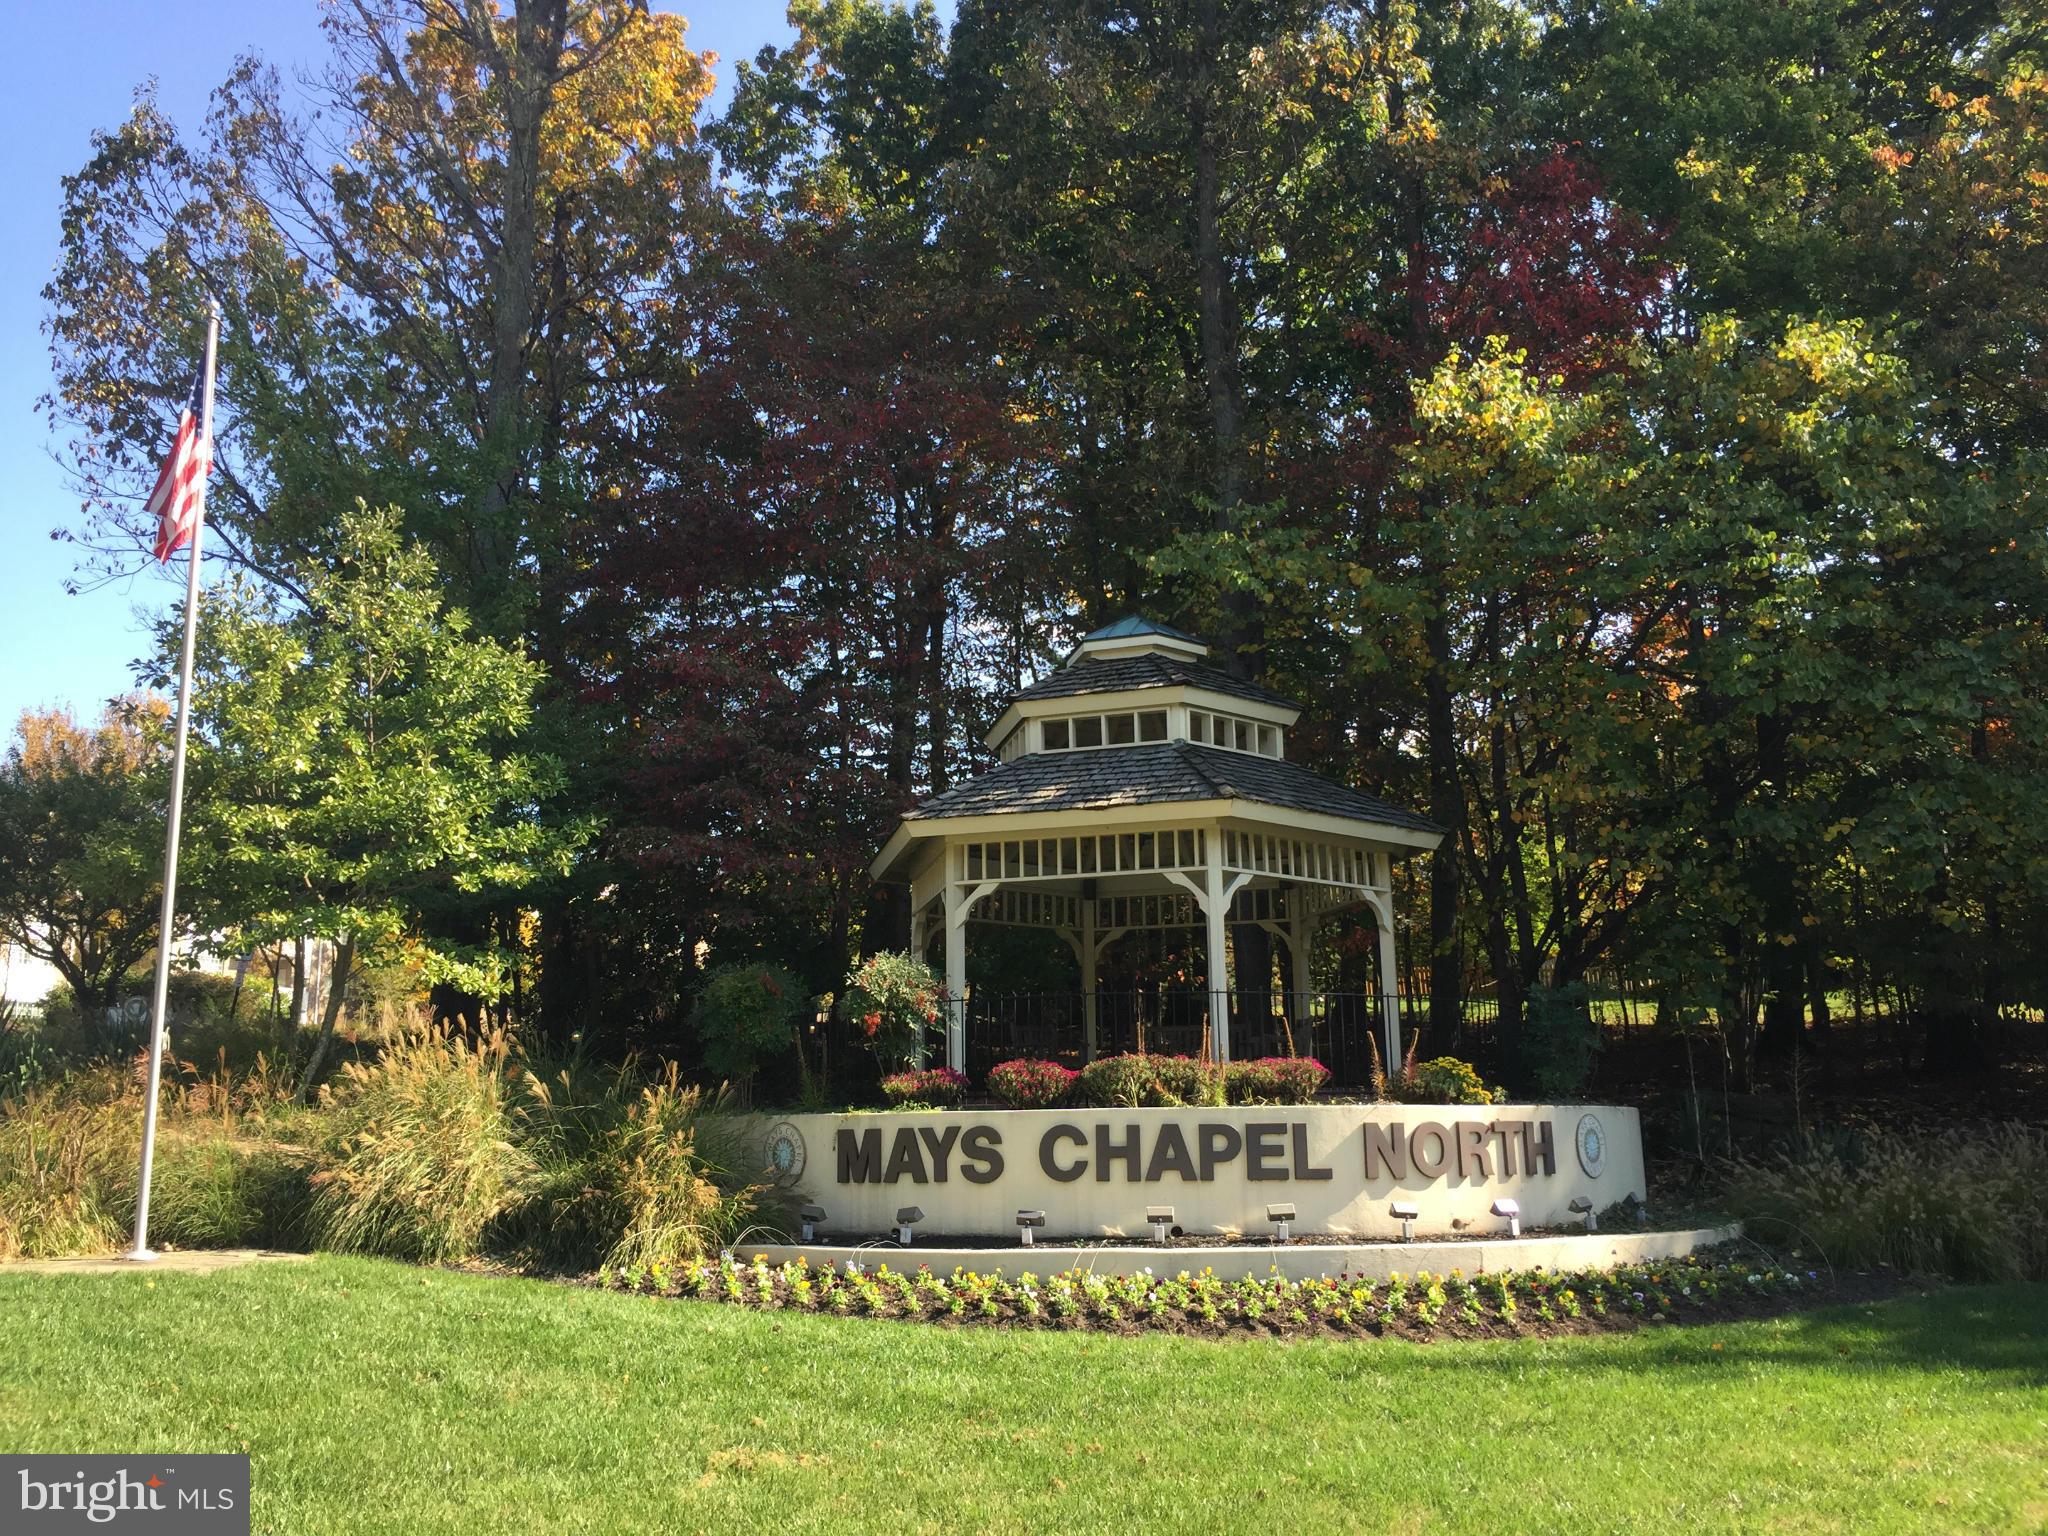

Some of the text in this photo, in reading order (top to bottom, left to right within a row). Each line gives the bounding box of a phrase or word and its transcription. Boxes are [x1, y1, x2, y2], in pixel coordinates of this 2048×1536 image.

[837, 1126, 1005, 1184] MAYS
[1038, 1122, 1333, 1183] CHAPEL
[1362, 1119, 1556, 1180] NORTH
